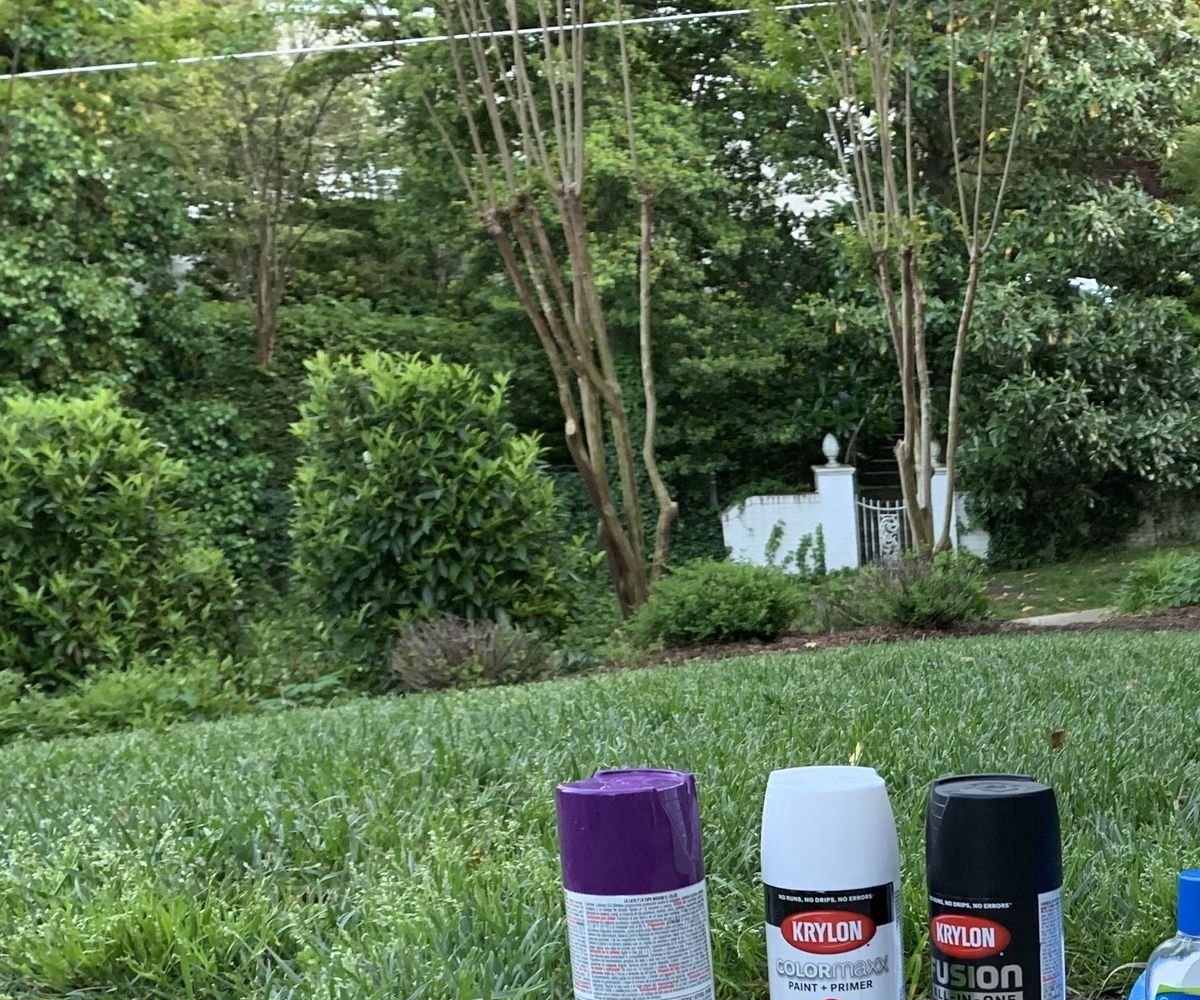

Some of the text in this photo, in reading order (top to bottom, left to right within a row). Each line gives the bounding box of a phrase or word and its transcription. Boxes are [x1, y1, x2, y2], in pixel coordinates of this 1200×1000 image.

[792, 920, 863, 943] KRYLON
[935, 922, 995, 948] KRYLON
[789, 981, 818, 992] PAINT
[831, 980, 873, 992] PRIMER
